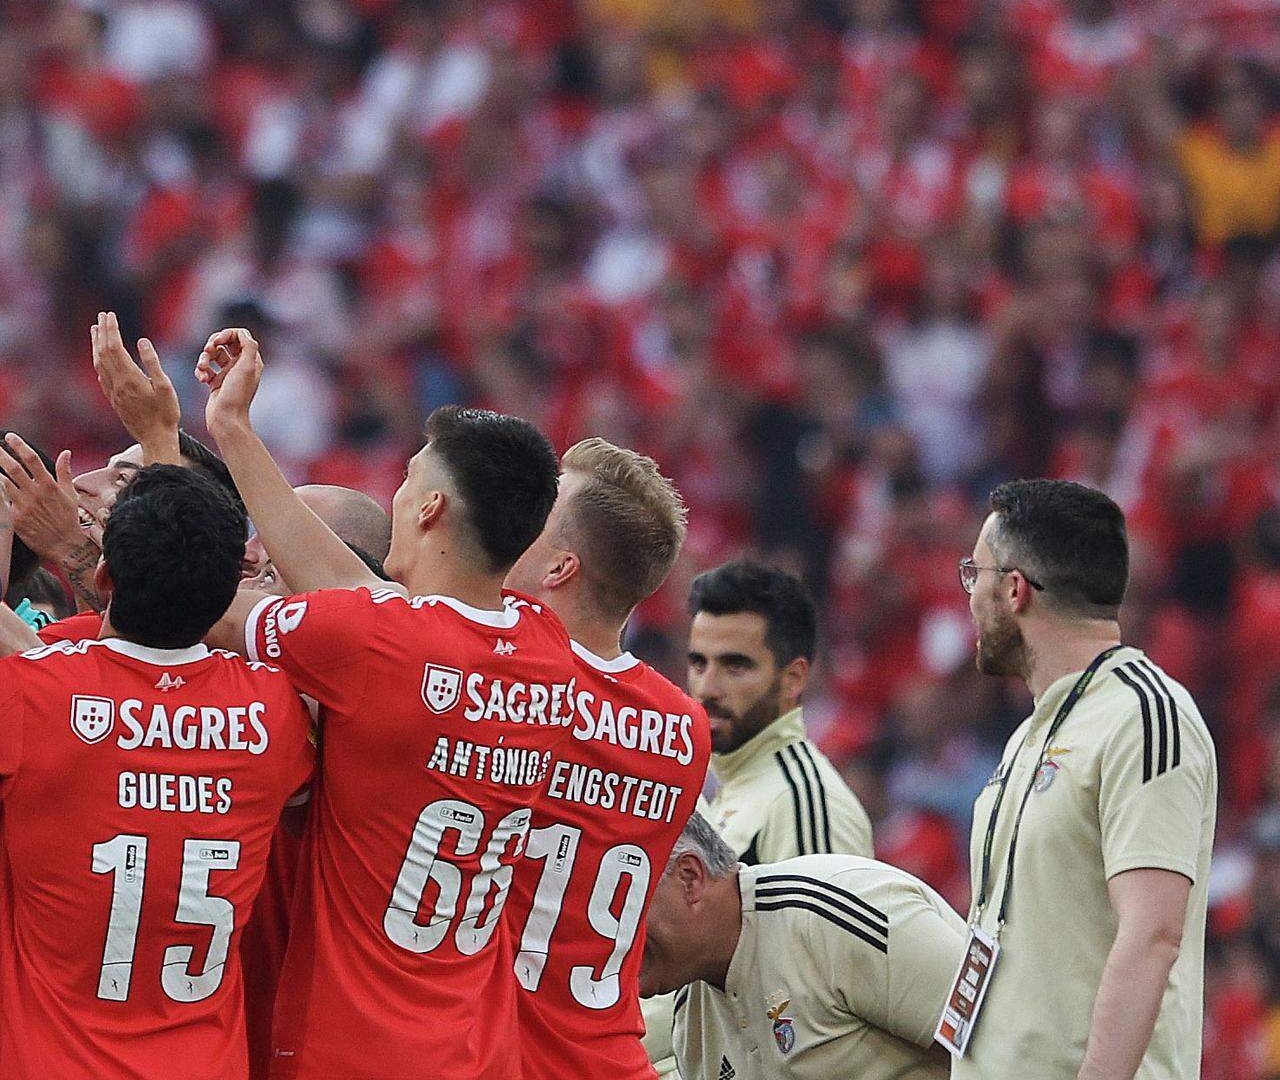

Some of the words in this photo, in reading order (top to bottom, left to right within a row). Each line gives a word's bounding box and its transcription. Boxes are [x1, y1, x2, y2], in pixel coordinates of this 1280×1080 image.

[117, 698, 269, 755] SAGRES
[464, 673, 576, 728] SAGRES
[573, 691, 694, 766] SAGRES
[118, 771, 233, 814] GUEDES
[547, 761, 683, 823] ENGSTEDT
[383, 799, 532, 956] 66
[92, 834, 241, 1003] 15
[513, 823, 651, 1010] 19
